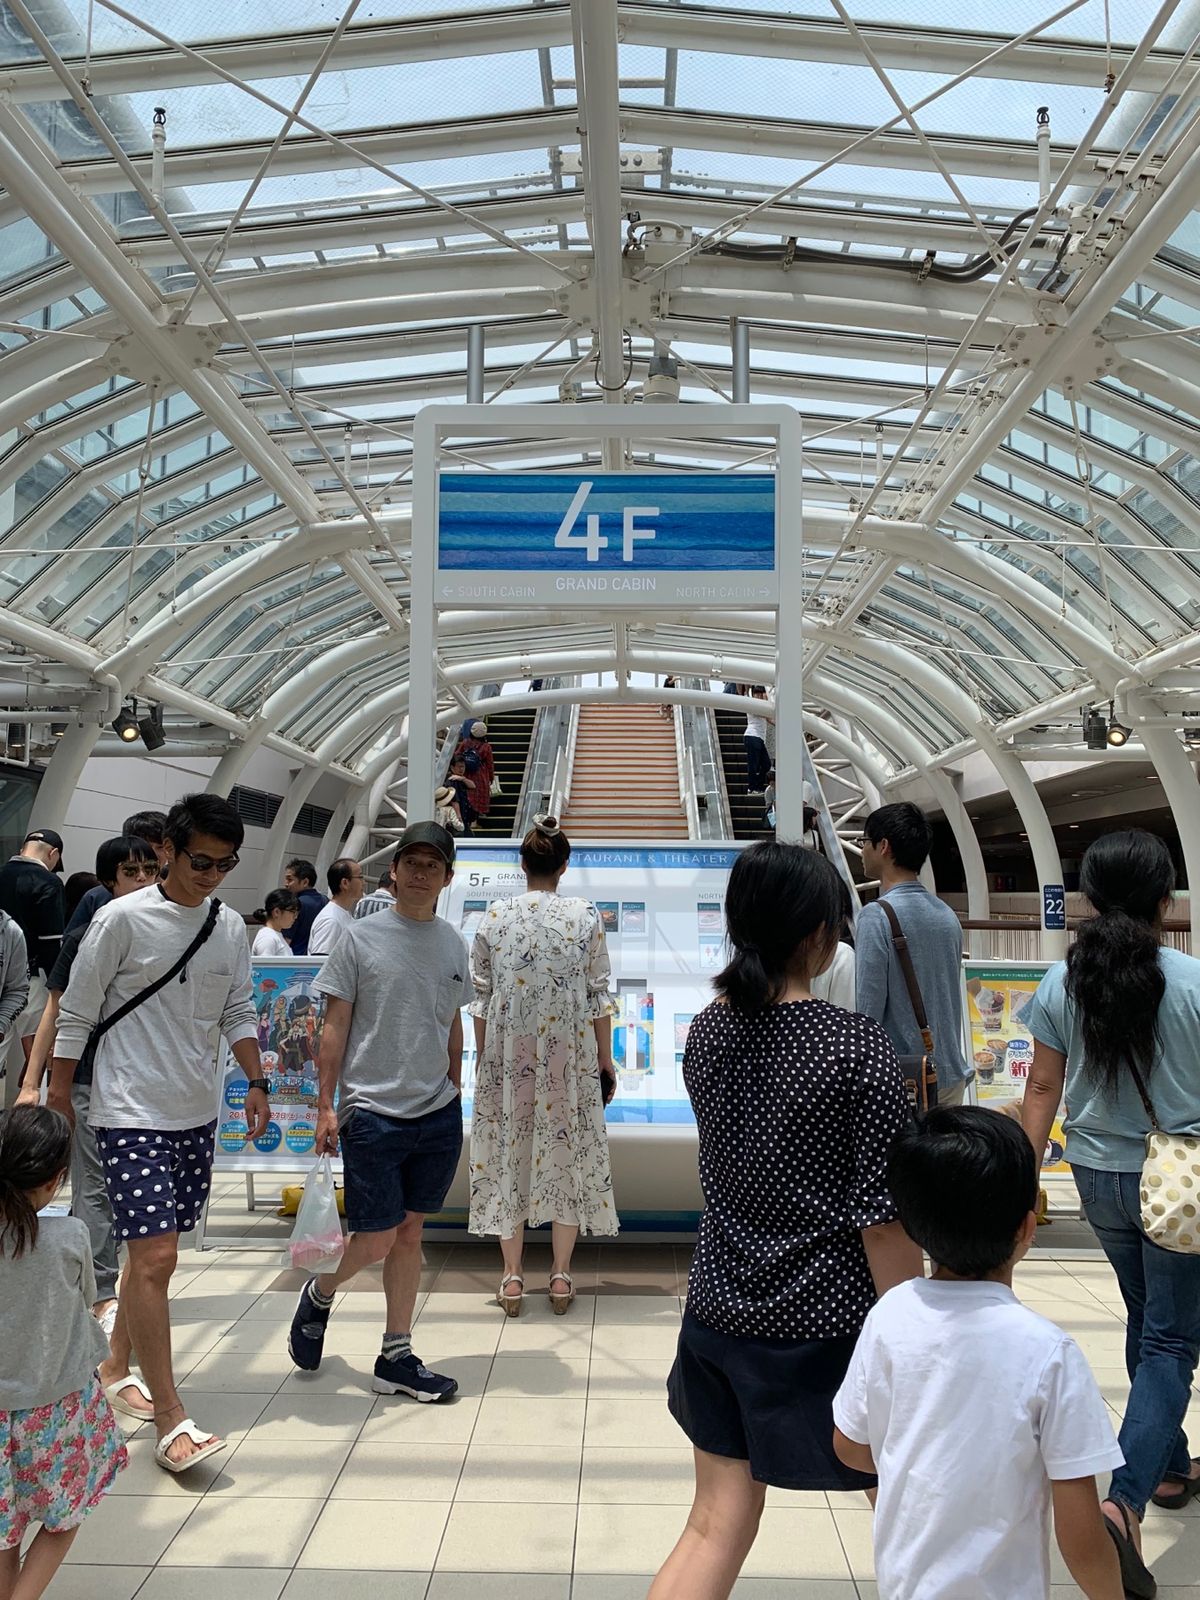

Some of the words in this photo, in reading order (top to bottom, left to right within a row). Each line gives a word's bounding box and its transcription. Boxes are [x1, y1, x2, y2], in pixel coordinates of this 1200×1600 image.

[556, 577, 607, 591] GRAND
[612, 577, 656, 591] CABIN
[458, 586, 496, 597] SOUTH
[500, 586, 535, 597] CABIN
[676, 587, 715, 597] NORTH
[648, 854, 656, 863] &
[663, 854, 728, 863] THEATER
[469, 873, 490, 887] 5F
[1046, 899, 1064, 914] 22
